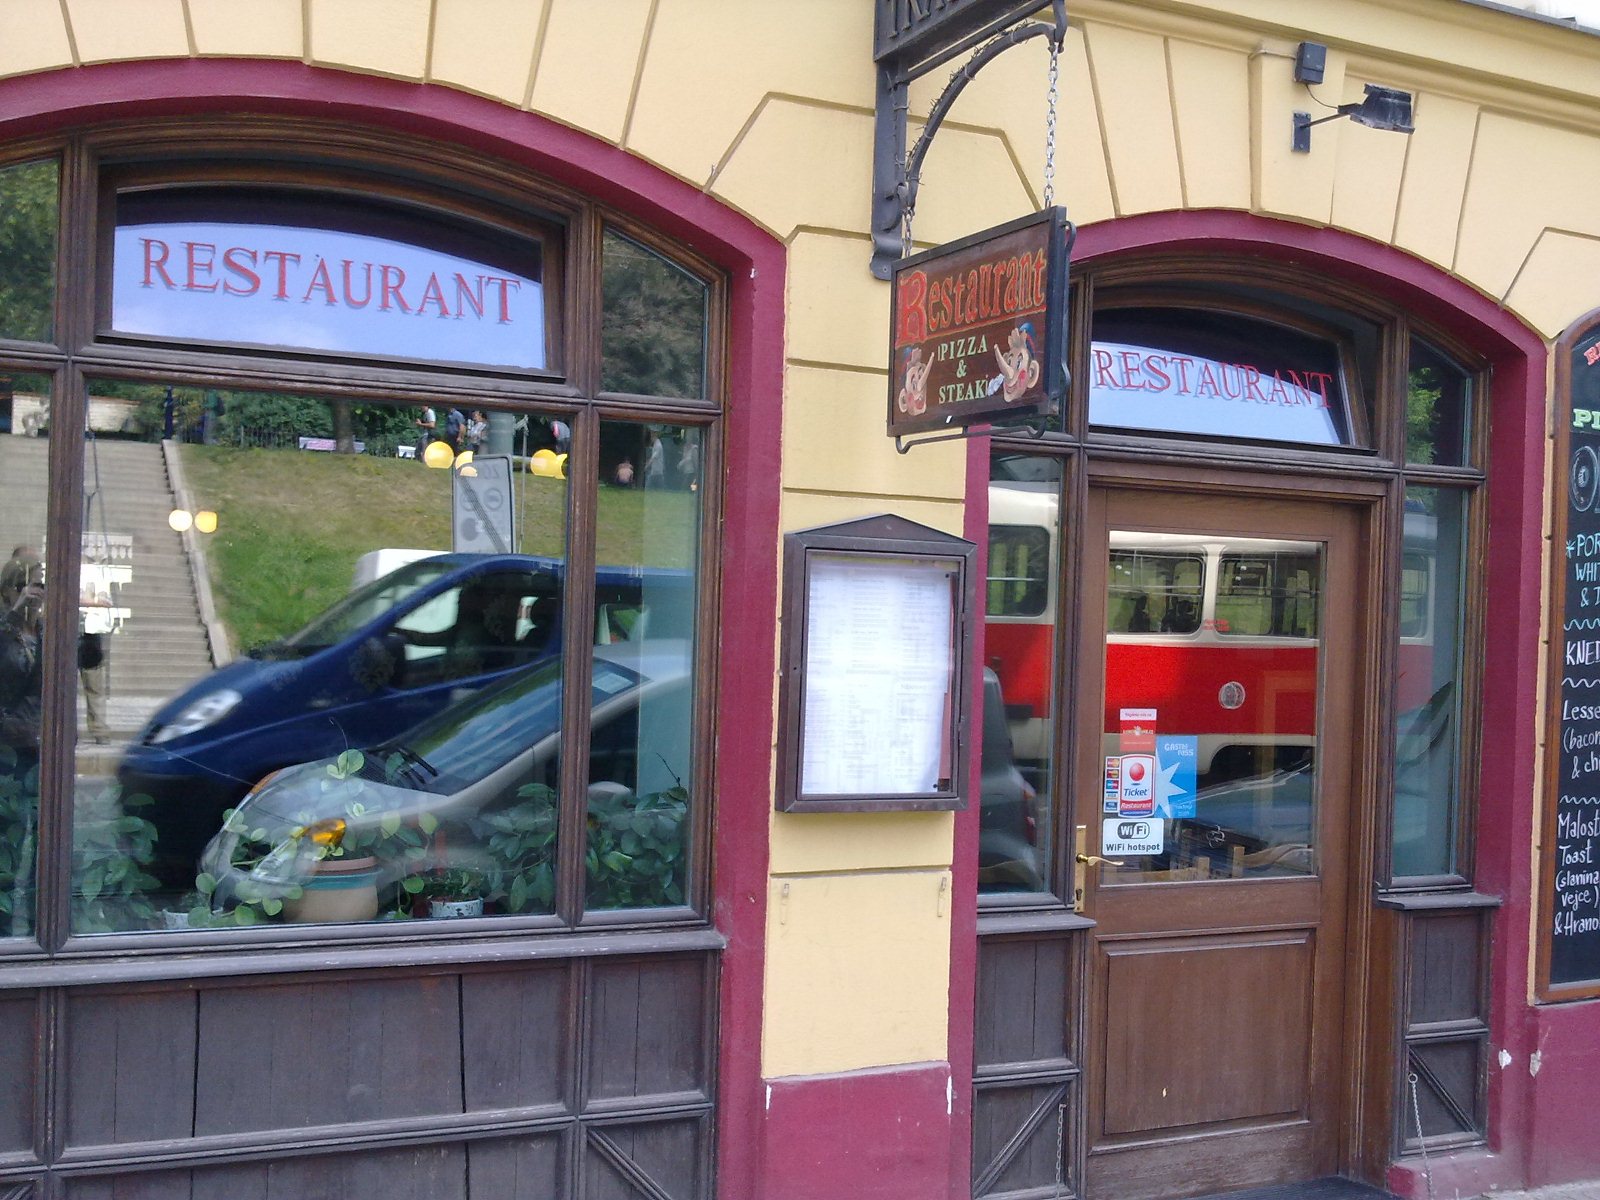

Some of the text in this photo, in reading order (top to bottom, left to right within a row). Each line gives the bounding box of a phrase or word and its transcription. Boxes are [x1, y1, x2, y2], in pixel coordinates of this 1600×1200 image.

[138, 236, 522, 325] RESTAURANT
[895, 248, 1047, 349] Restaurant
[938, 335, 988, 362] PIZZA
[956, 359, 967, 379] &
[1093, 349, 1332, 408] RESTAURANT
[1123, 788, 1148, 797] Ticket
[1105, 843, 1161, 853] WiFi hotspot
[1558, 839, 1592, 867] Toast
